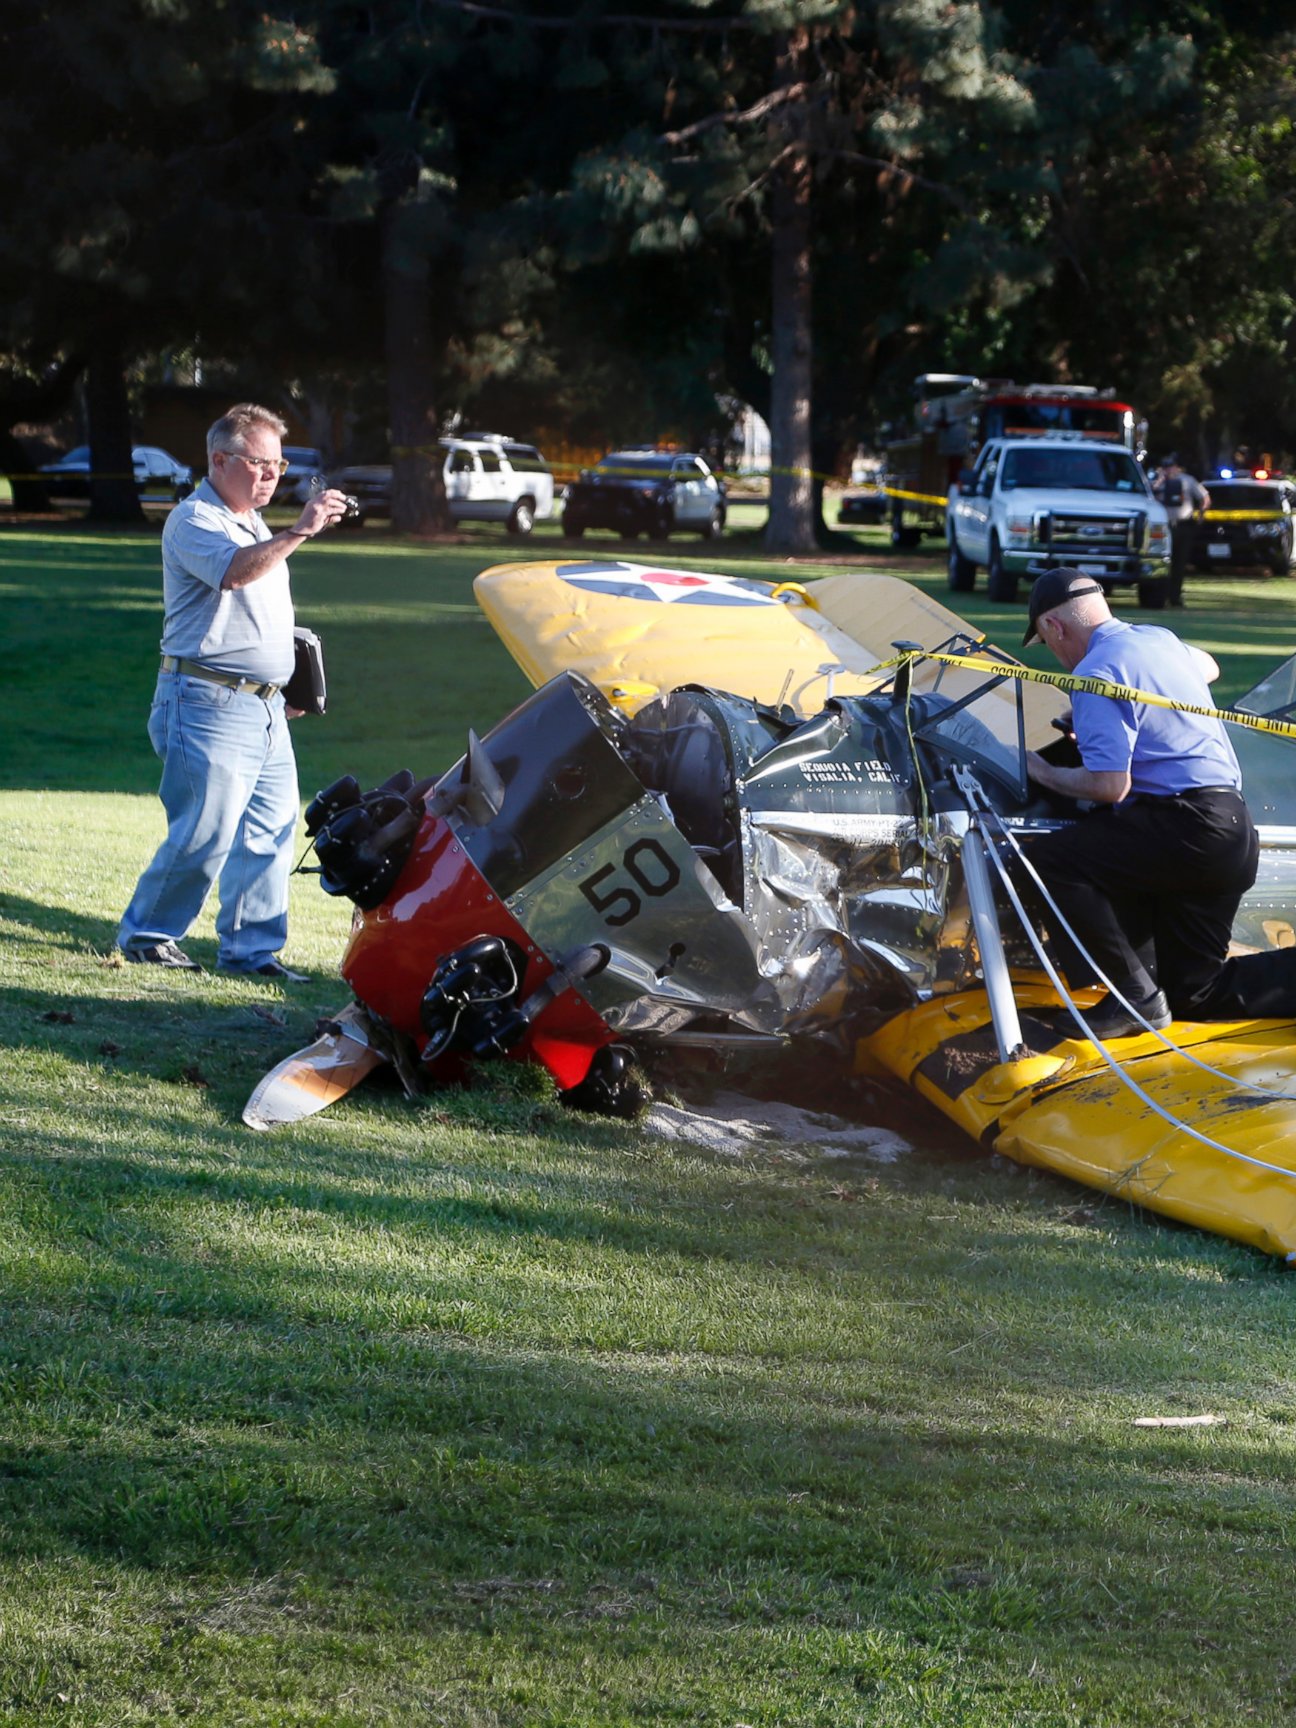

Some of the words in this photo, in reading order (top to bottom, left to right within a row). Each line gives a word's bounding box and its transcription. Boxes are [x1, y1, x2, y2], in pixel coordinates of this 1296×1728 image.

[1058, 677, 1075, 689] DO
[1079, 679, 1106, 696] LINE
[1111, 686, 1139, 701] FIRE
[1242, 714, 1258, 727] DO
[799, 761, 851, 773] SEQUOIA
[854, 760, 892, 772] FIELD
[578, 837, 681, 927] 50
